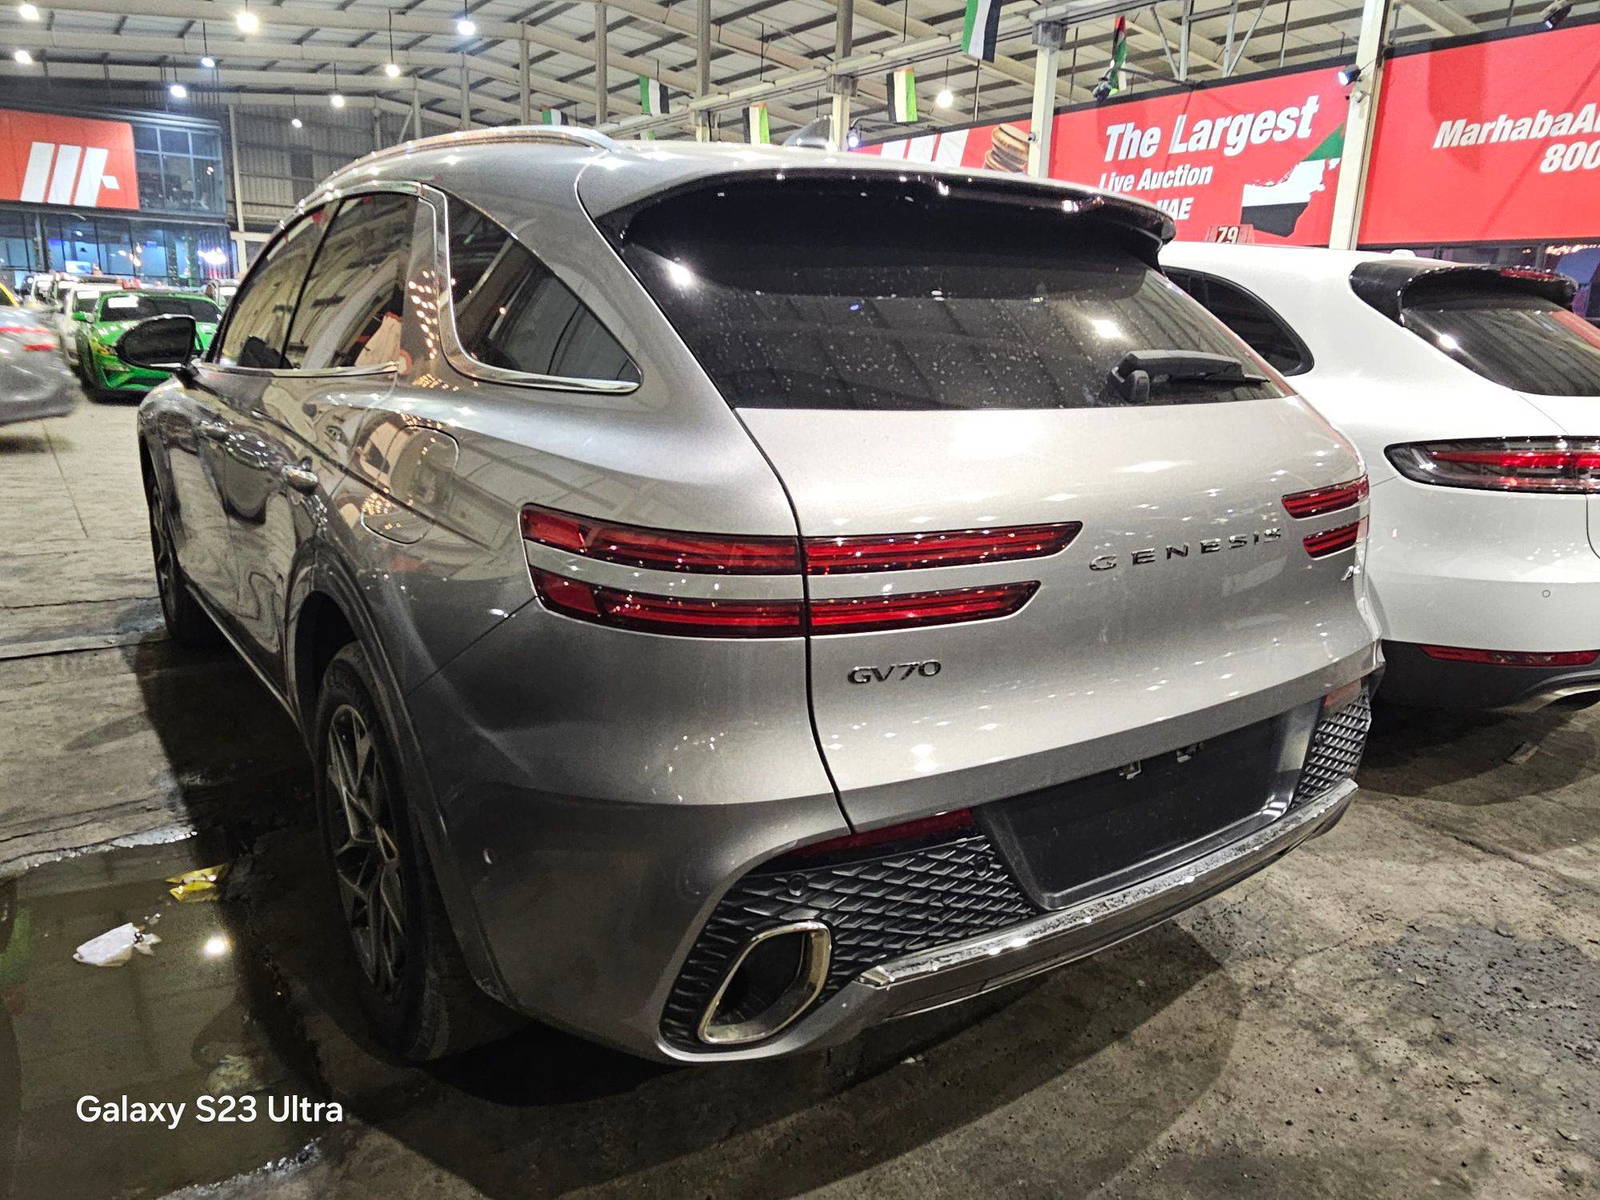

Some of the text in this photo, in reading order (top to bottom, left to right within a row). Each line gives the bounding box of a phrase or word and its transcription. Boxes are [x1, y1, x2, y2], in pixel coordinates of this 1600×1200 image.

[1104, 95, 1320, 162] The Largest
[1098, 163, 1214, 193] Live Auction
[1216, 226, 1239, 243] 79
[1089, 527, 1281, 571] GENESIS
[847, 659, 942, 684] GV70
